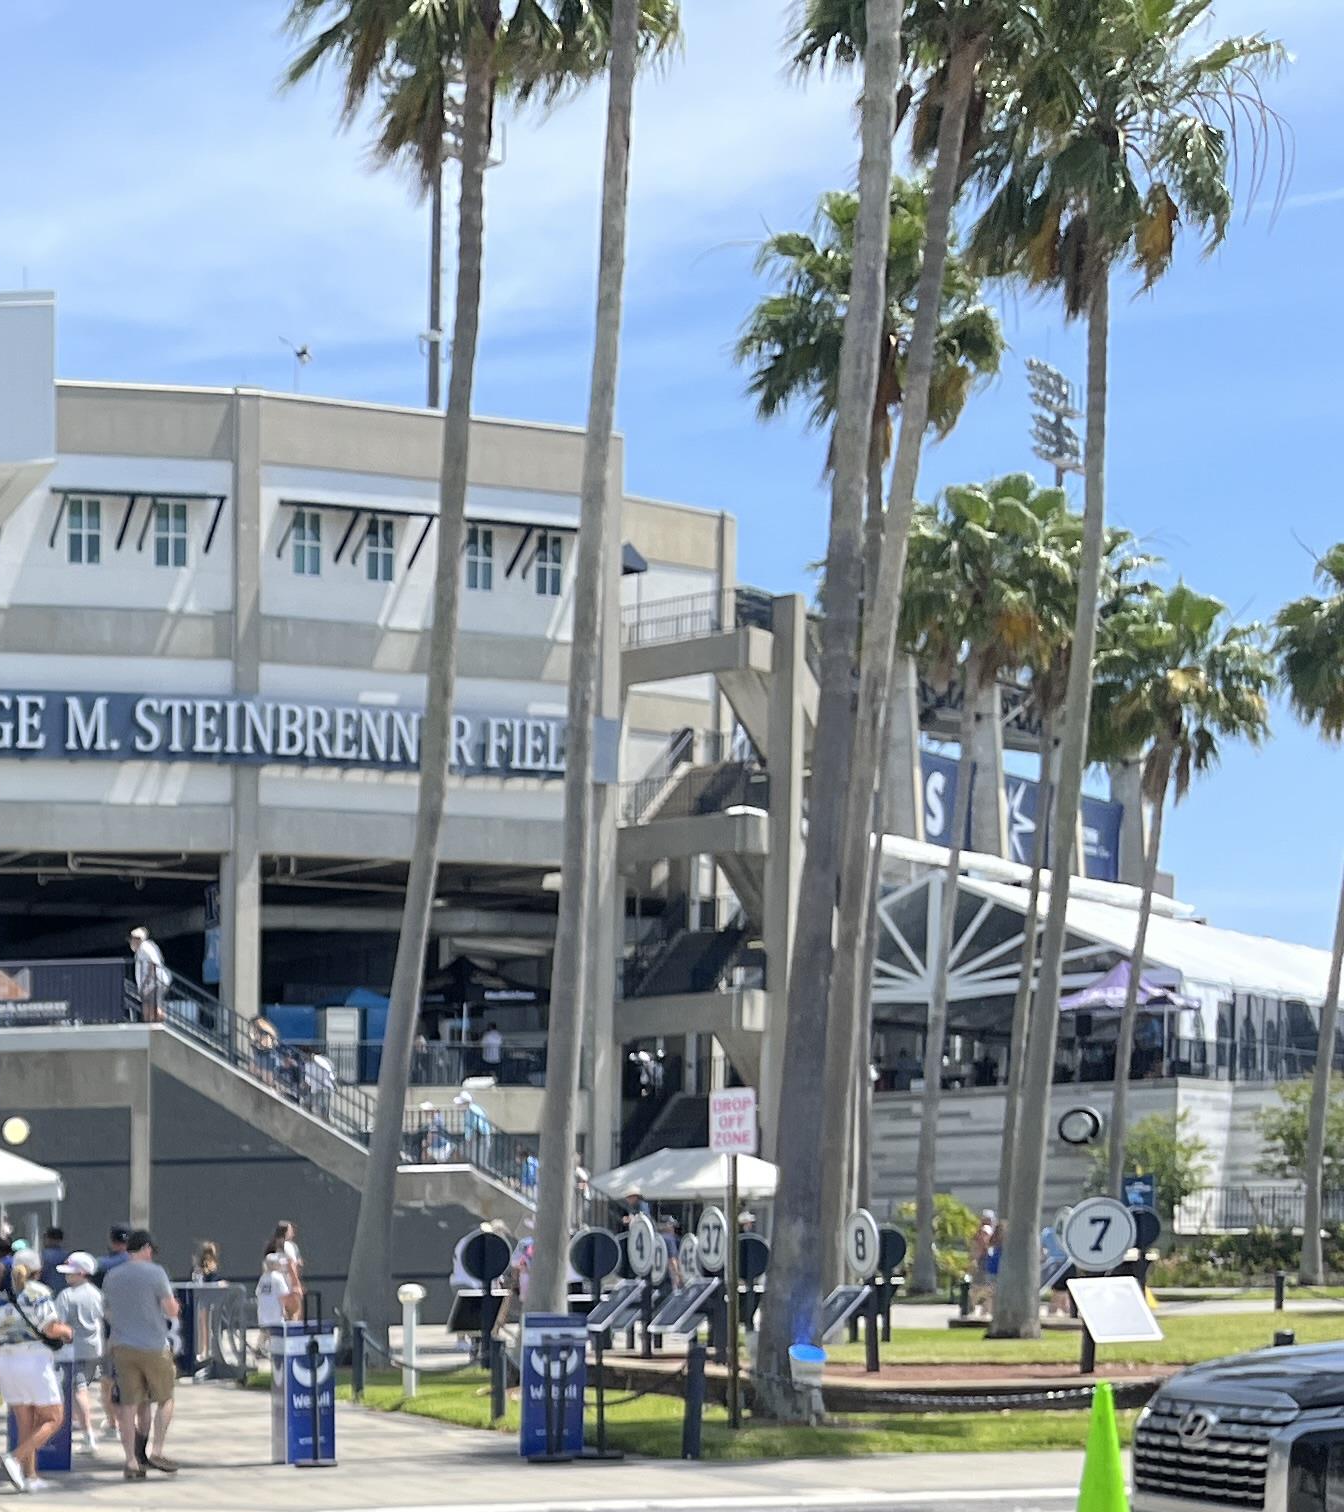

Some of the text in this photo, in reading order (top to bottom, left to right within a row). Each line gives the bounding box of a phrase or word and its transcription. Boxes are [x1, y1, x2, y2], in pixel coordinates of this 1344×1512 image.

[65, 696, 120, 750] M.
[134, 698, 475, 767] STEINBRENNR
[713, 1097, 752, 1113] DROP
[719, 1114, 745, 1130] OFF
[714, 1130, 751, 1146] ZONE
[635, 1231, 645, 1261] 4
[702, 1224, 721, 1255] 37
[855, 1229, 866, 1261] 8
[1089, 1216, 1112, 1252] 7
[293, 1392, 330, 1409] Weull
